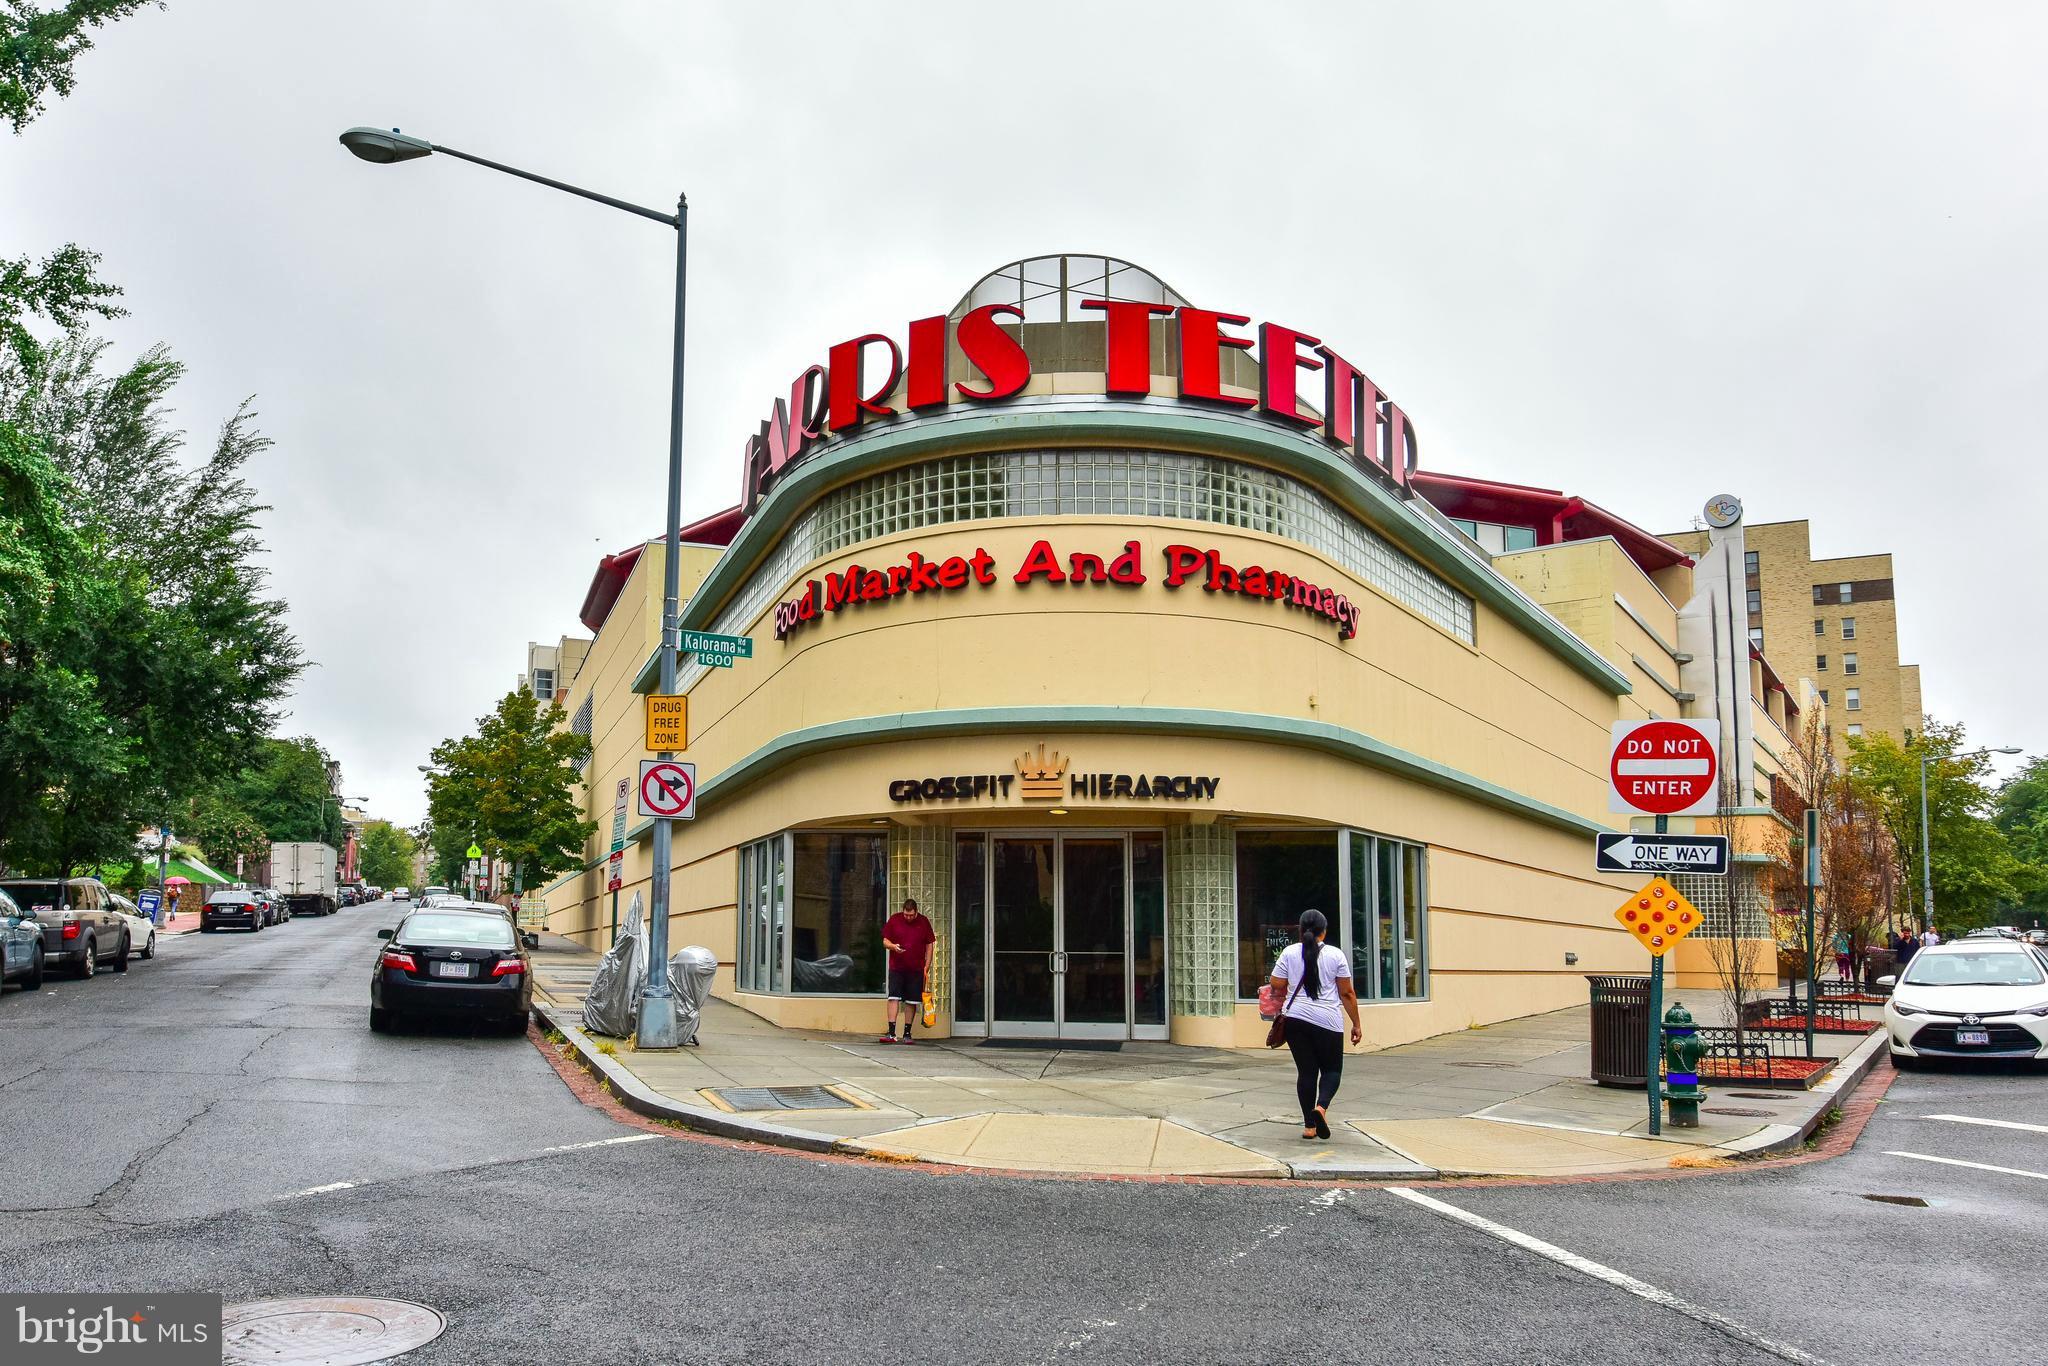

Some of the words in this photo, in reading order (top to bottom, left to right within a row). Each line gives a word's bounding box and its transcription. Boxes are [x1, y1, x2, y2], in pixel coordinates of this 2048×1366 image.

[741, 304, 1032, 517] HARRIS
[1080, 299, 1418, 500] TEETER
[773, 579, 823, 641] Food
[824, 547, 997, 613] Market
[1013, 540, 1147, 585] And
[1162, 544, 1360, 641] Pharmacy
[685, 633, 736, 653] Kalorama
[737, 637, 746, 646] Rd
[699, 653, 732, 667] 1600
[653, 702, 682, 713] DRUG
[654, 717, 681, 729] FREE
[654, 733, 679, 744] ZONE
[1627, 739, 1653, 754] DO
[1664, 739, 1701, 754] NOT
[888, 774, 1016, 803] CROSSFIT
[1070, 773, 1221, 800] HIERARCHY
[1632, 781, 1692, 796] ENTER
[1634, 846, 1668, 861] ONE
[1675, 847, 1712, 862] WAY
